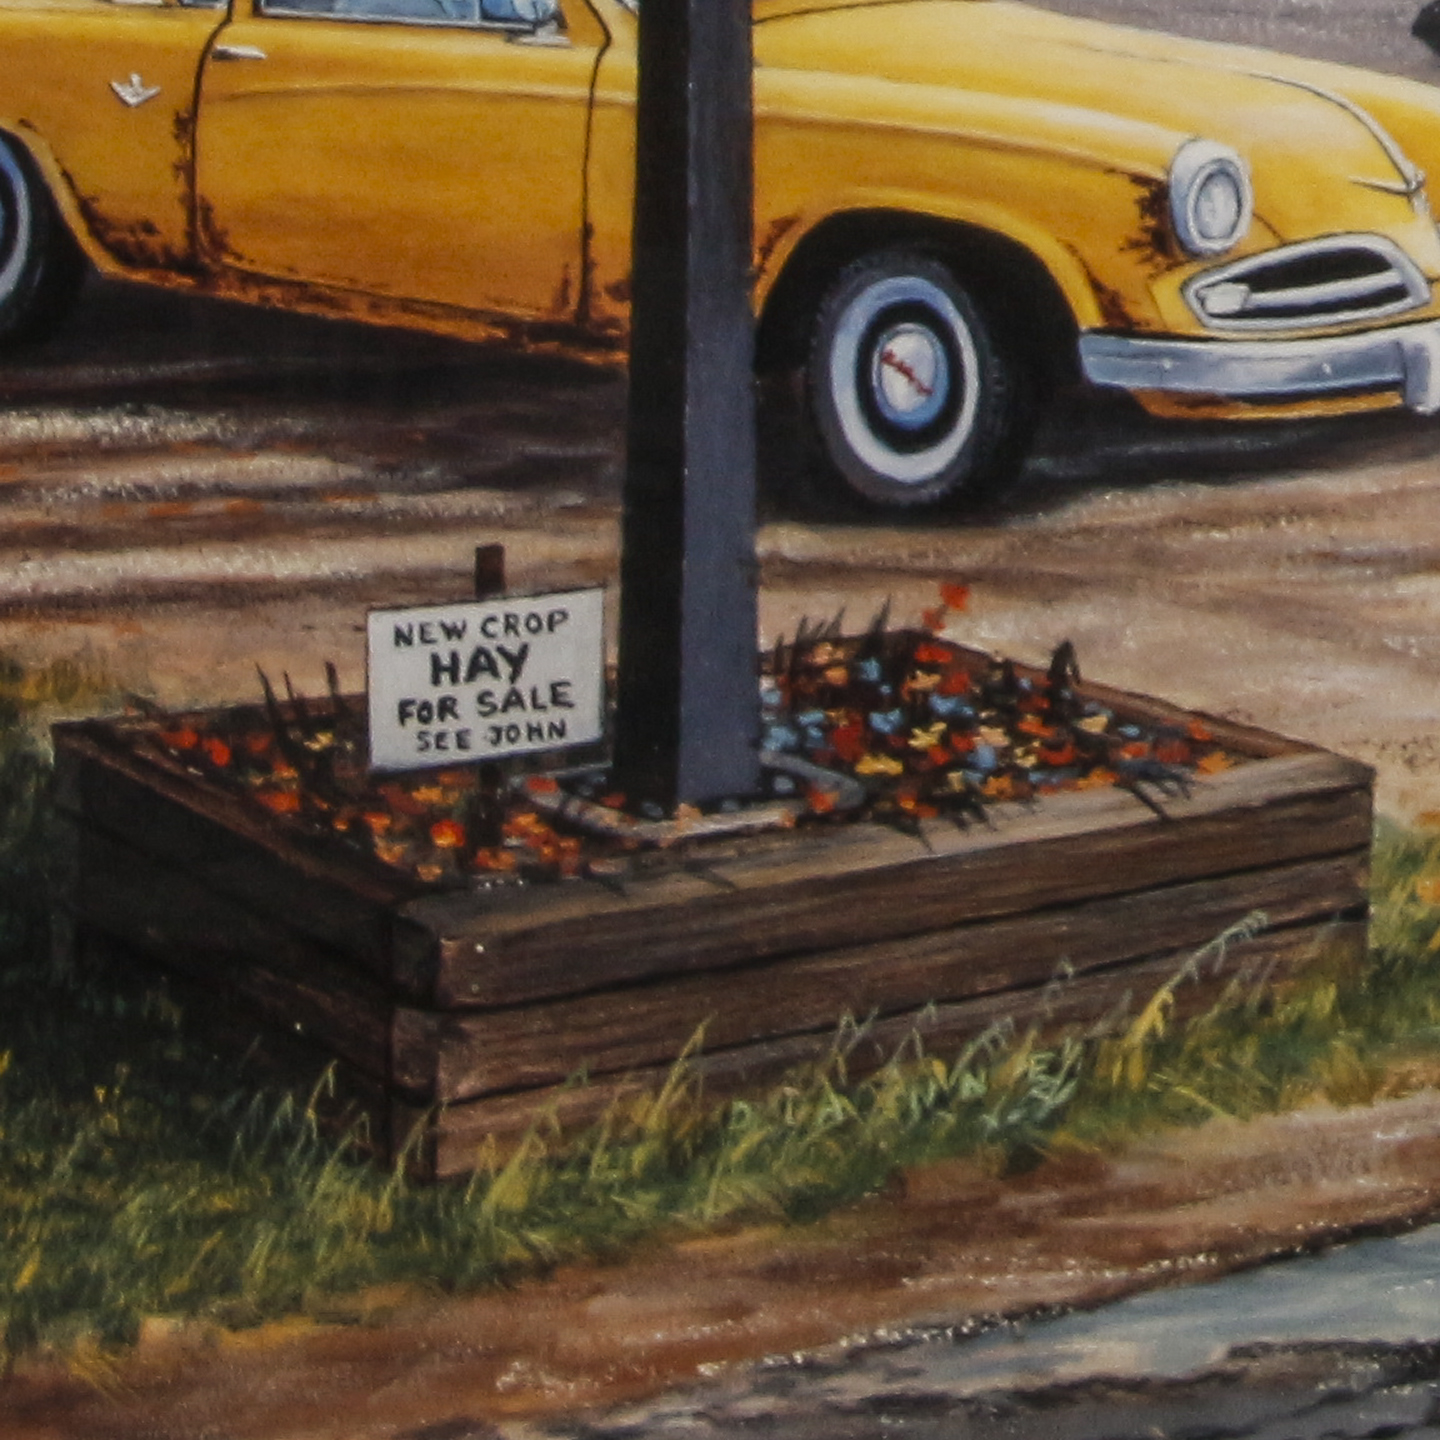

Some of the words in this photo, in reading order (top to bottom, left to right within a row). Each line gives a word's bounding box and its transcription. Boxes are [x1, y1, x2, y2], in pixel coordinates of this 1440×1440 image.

[393, 621, 468, 648] NEW
[480, 608, 570, 639] CROP
[428, 641, 530, 687] HAY
[397, 695, 460, 727] FOR
[476, 681, 575, 717] SALE
[416, 727, 472, 752] SEE
[486, 718, 567, 747] JOHN
